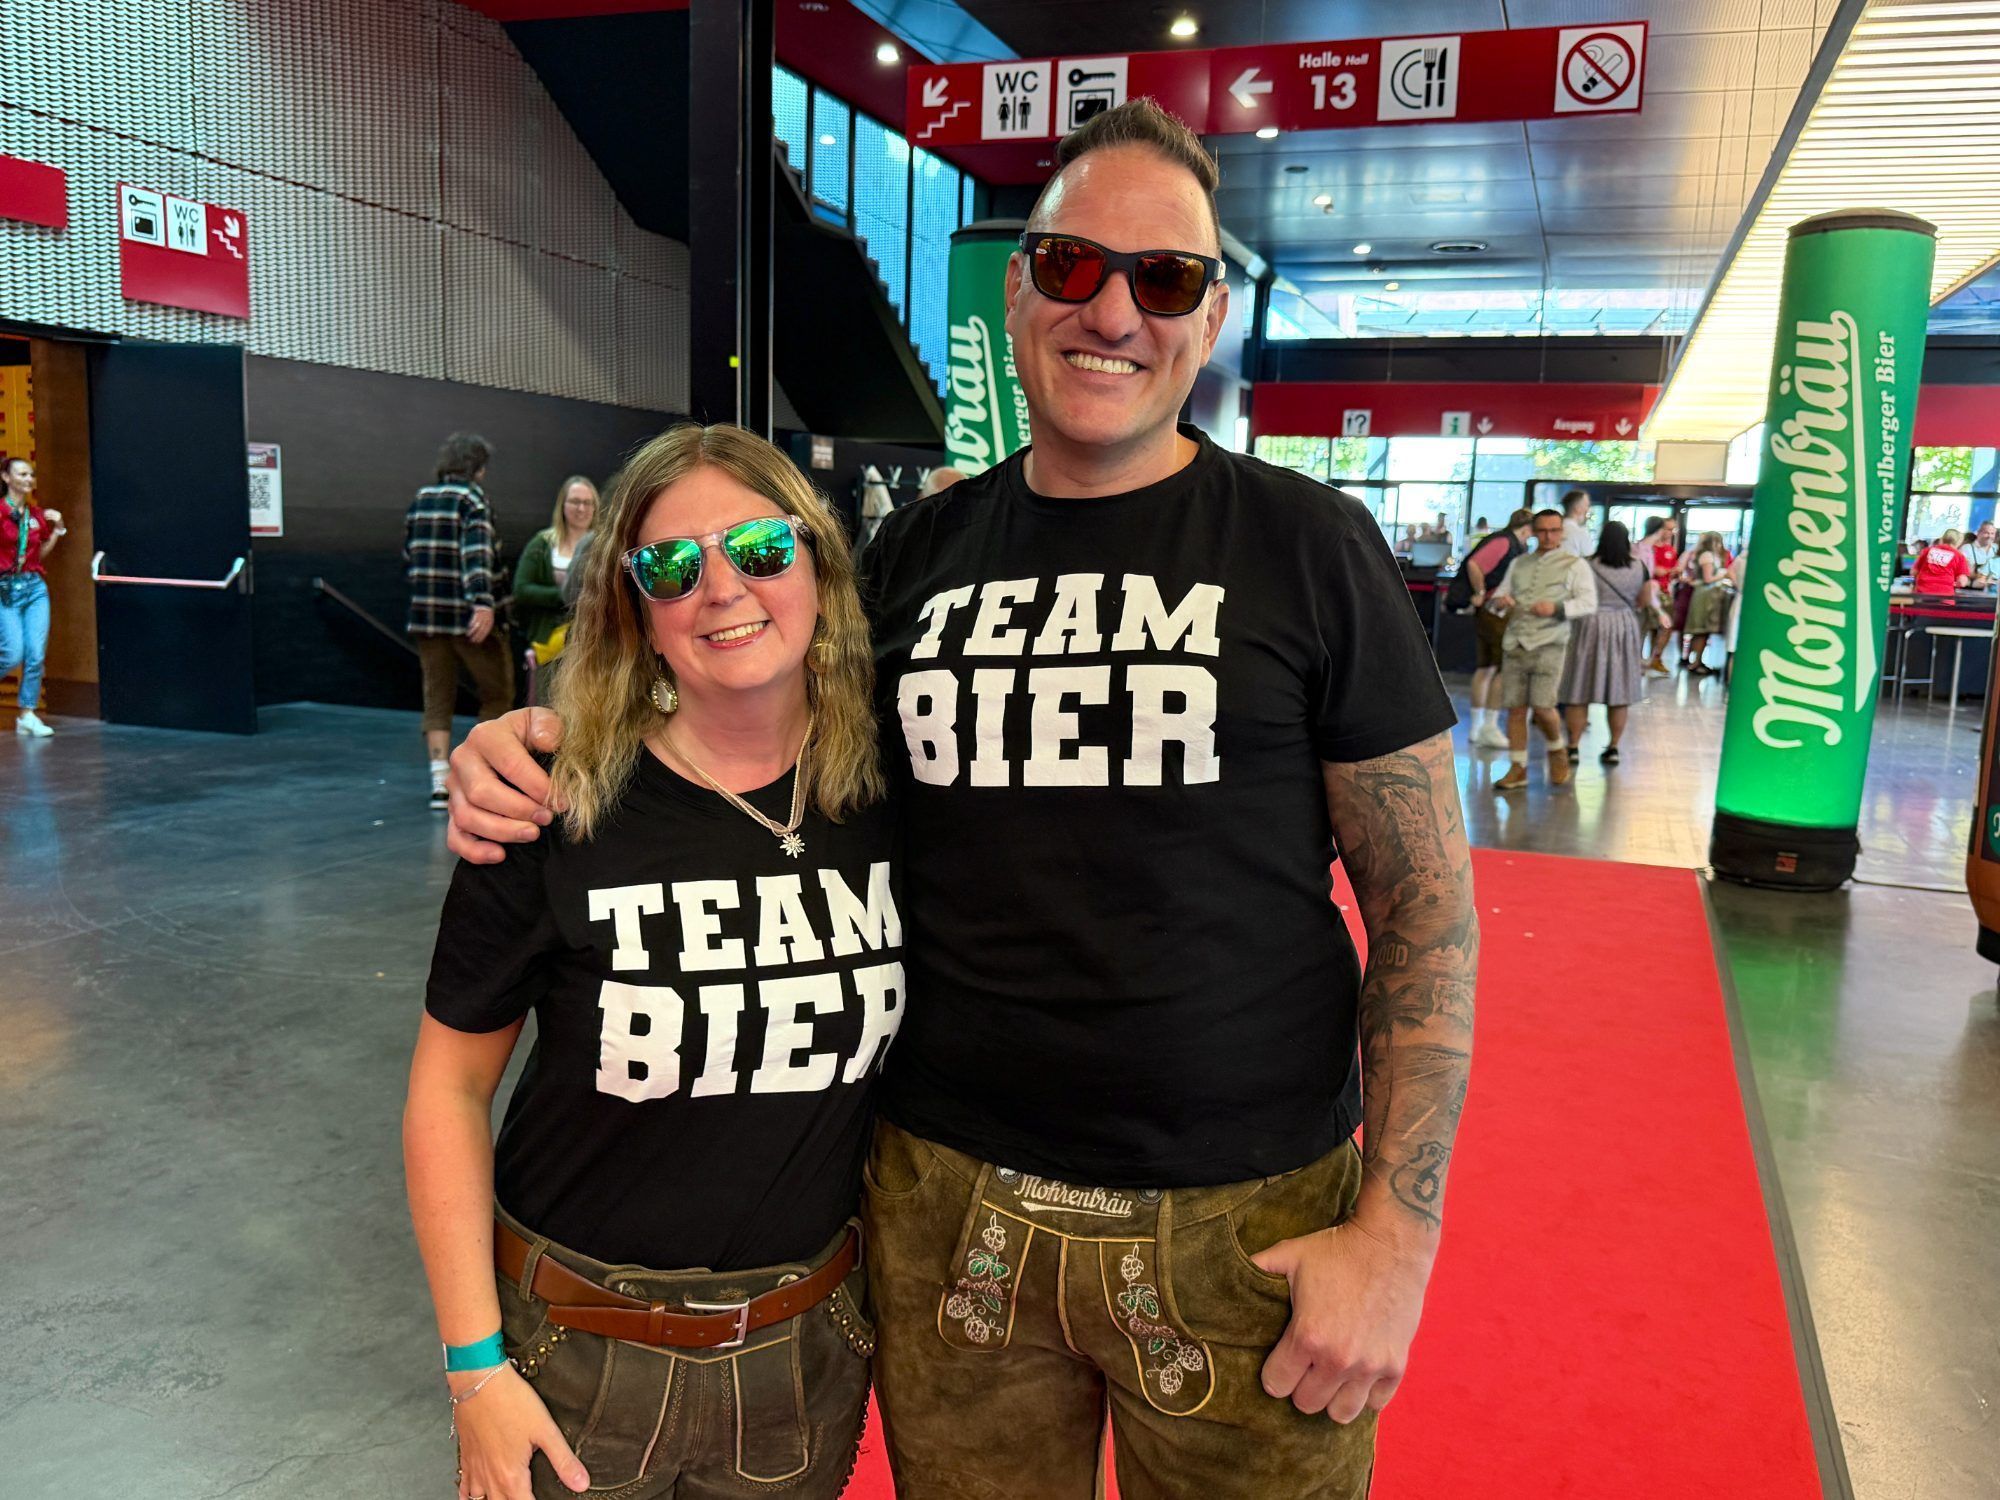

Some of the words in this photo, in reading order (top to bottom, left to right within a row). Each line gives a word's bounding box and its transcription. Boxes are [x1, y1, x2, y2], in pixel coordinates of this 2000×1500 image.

[995, 70, 1039, 94] WC
[1299, 51, 1341, 69] Halle
[1345, 53, 1369, 66] Hall
[1311, 72, 1357, 110] 13
[174, 203, 199, 223] WC
[1874, 330, 1896, 384] Bier
[1877, 390, 1900, 544] Vorarlberger
[1752, 310, 1857, 749] Mohrenbräu
[1876, 552, 1891, 592] das
[911, 573, 1225, 659] TEAM
[897, 665, 1220, 787] BIER
[588, 861, 903, 971] TEAM
[596, 961, 906, 1103] BIER
[1013, 1173, 1133, 1216] Mohrenbräu
